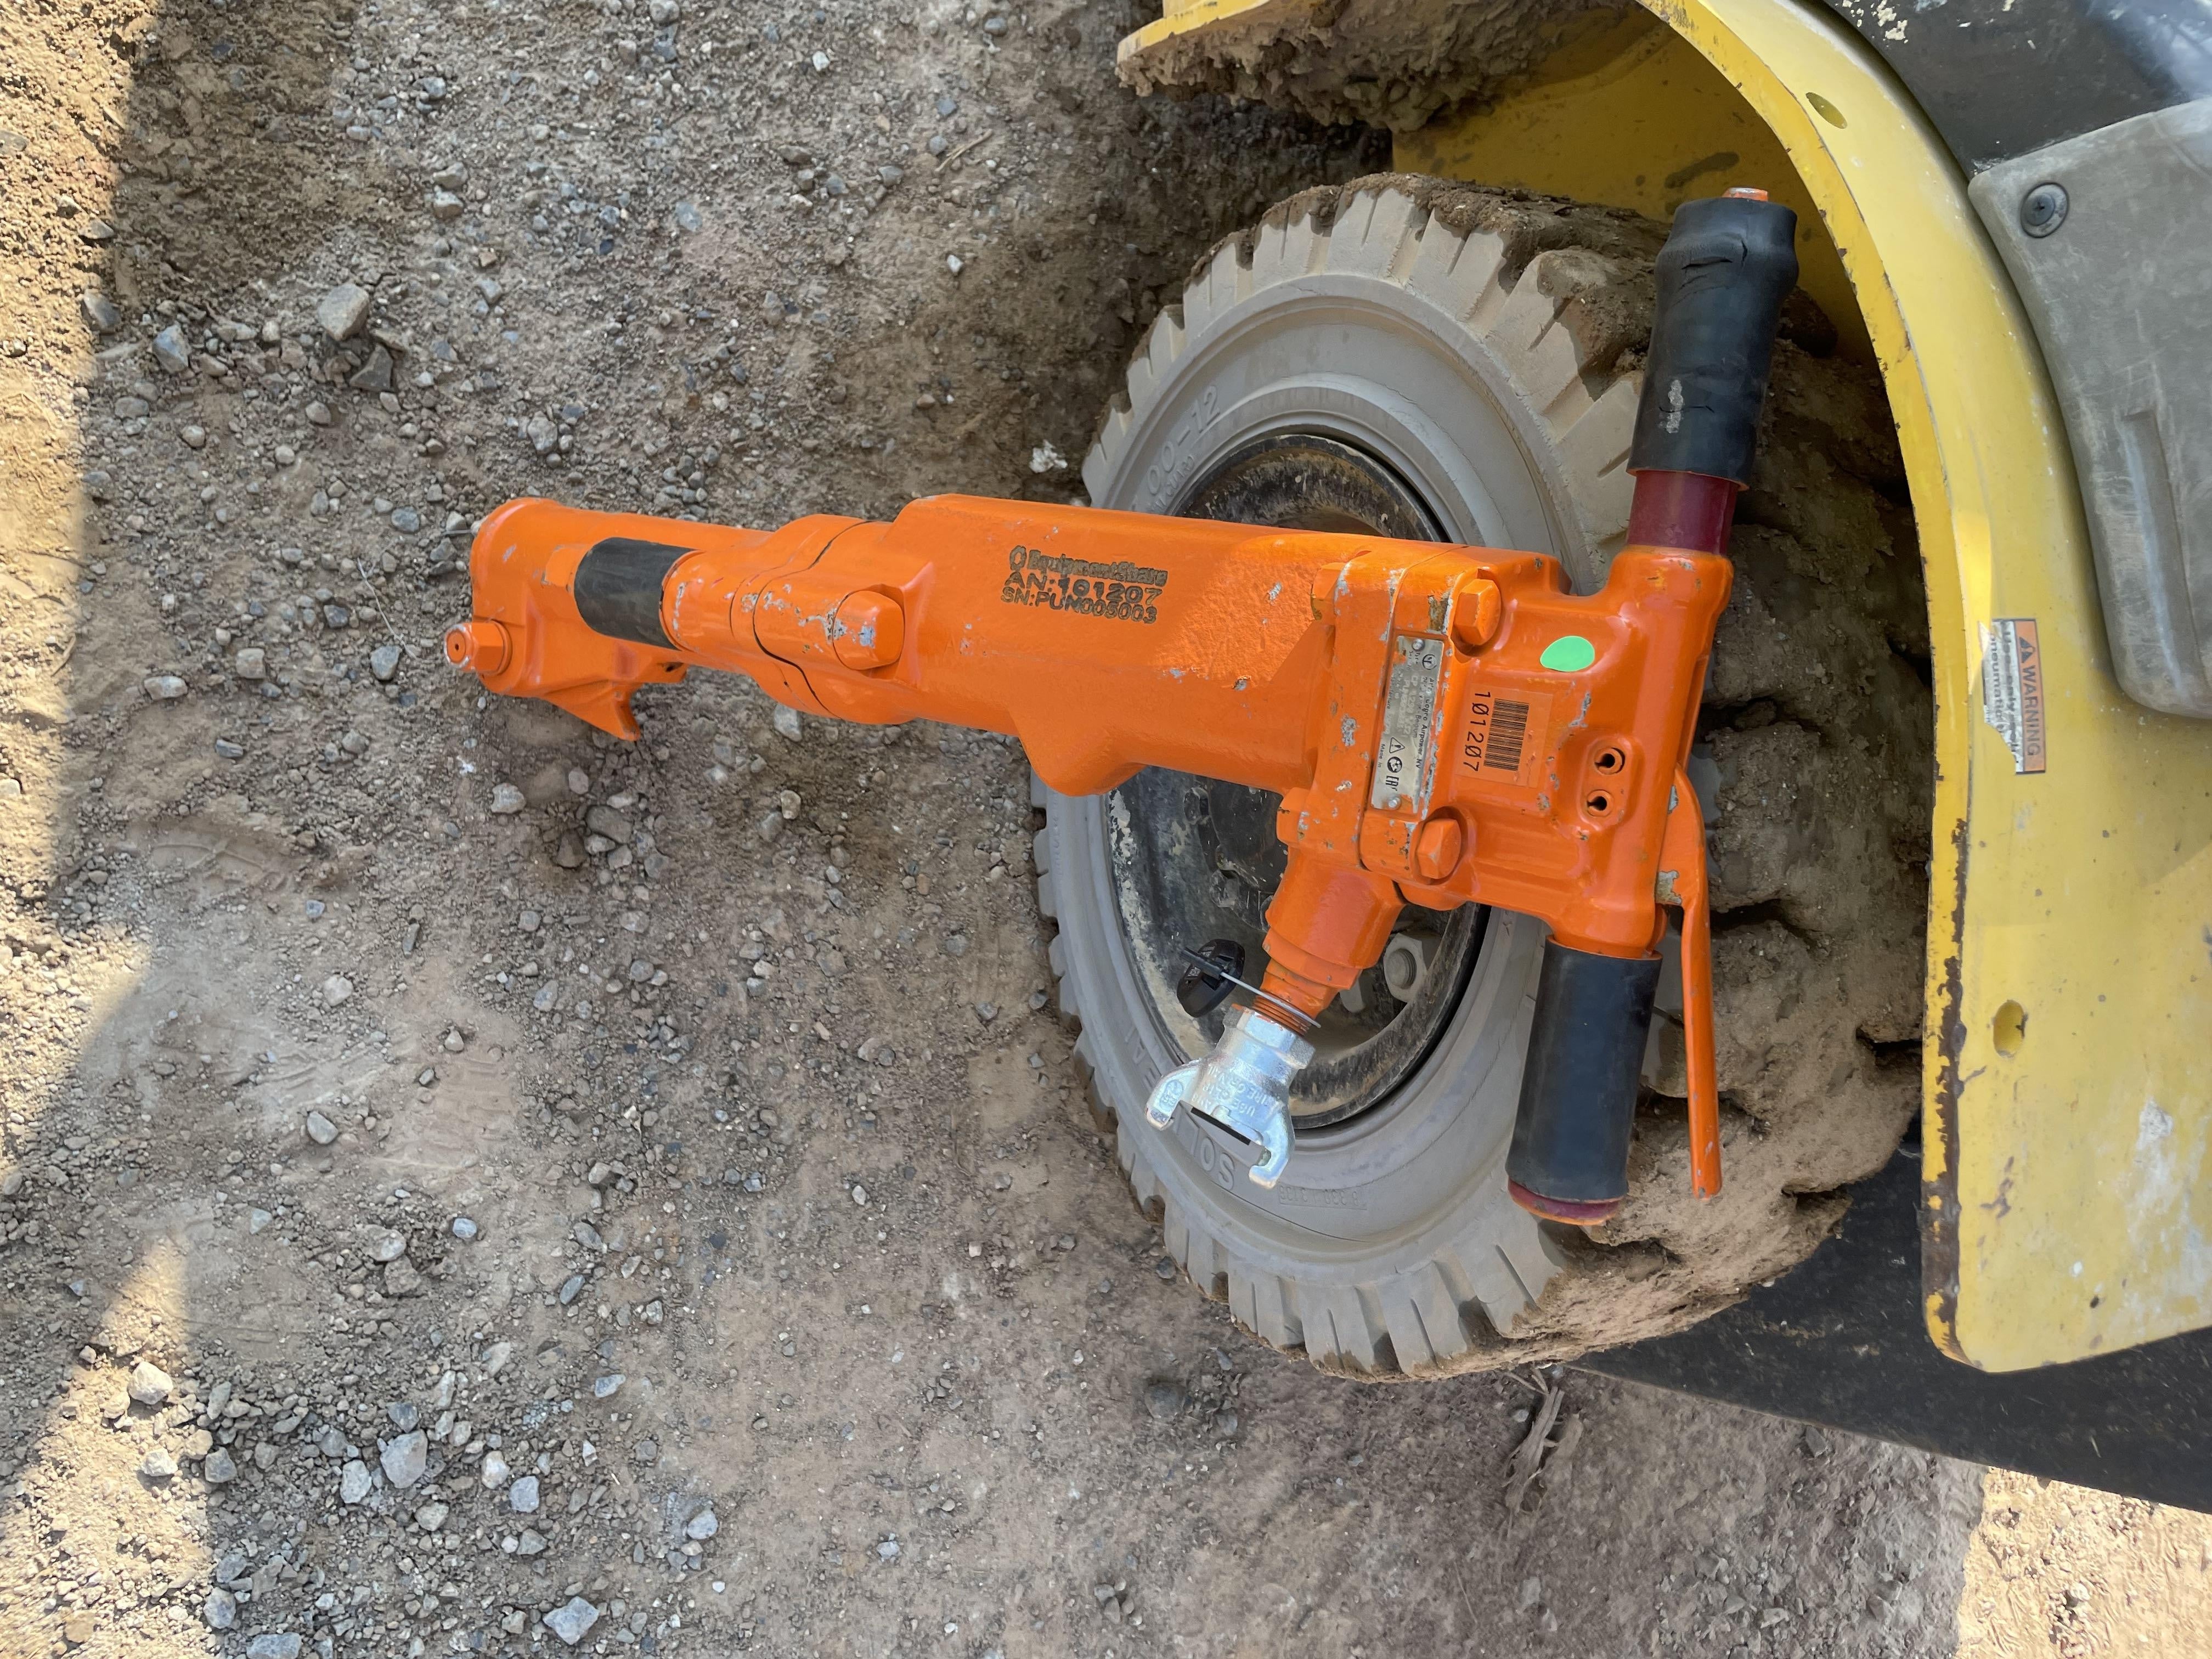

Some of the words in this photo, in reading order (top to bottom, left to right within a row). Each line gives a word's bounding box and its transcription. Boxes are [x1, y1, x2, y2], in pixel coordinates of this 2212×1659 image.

[1418, 724, 1427, 755] Airpower
[1463, 692, 1491, 772] 101207
[2022, 665, 2041, 756] WARNING
